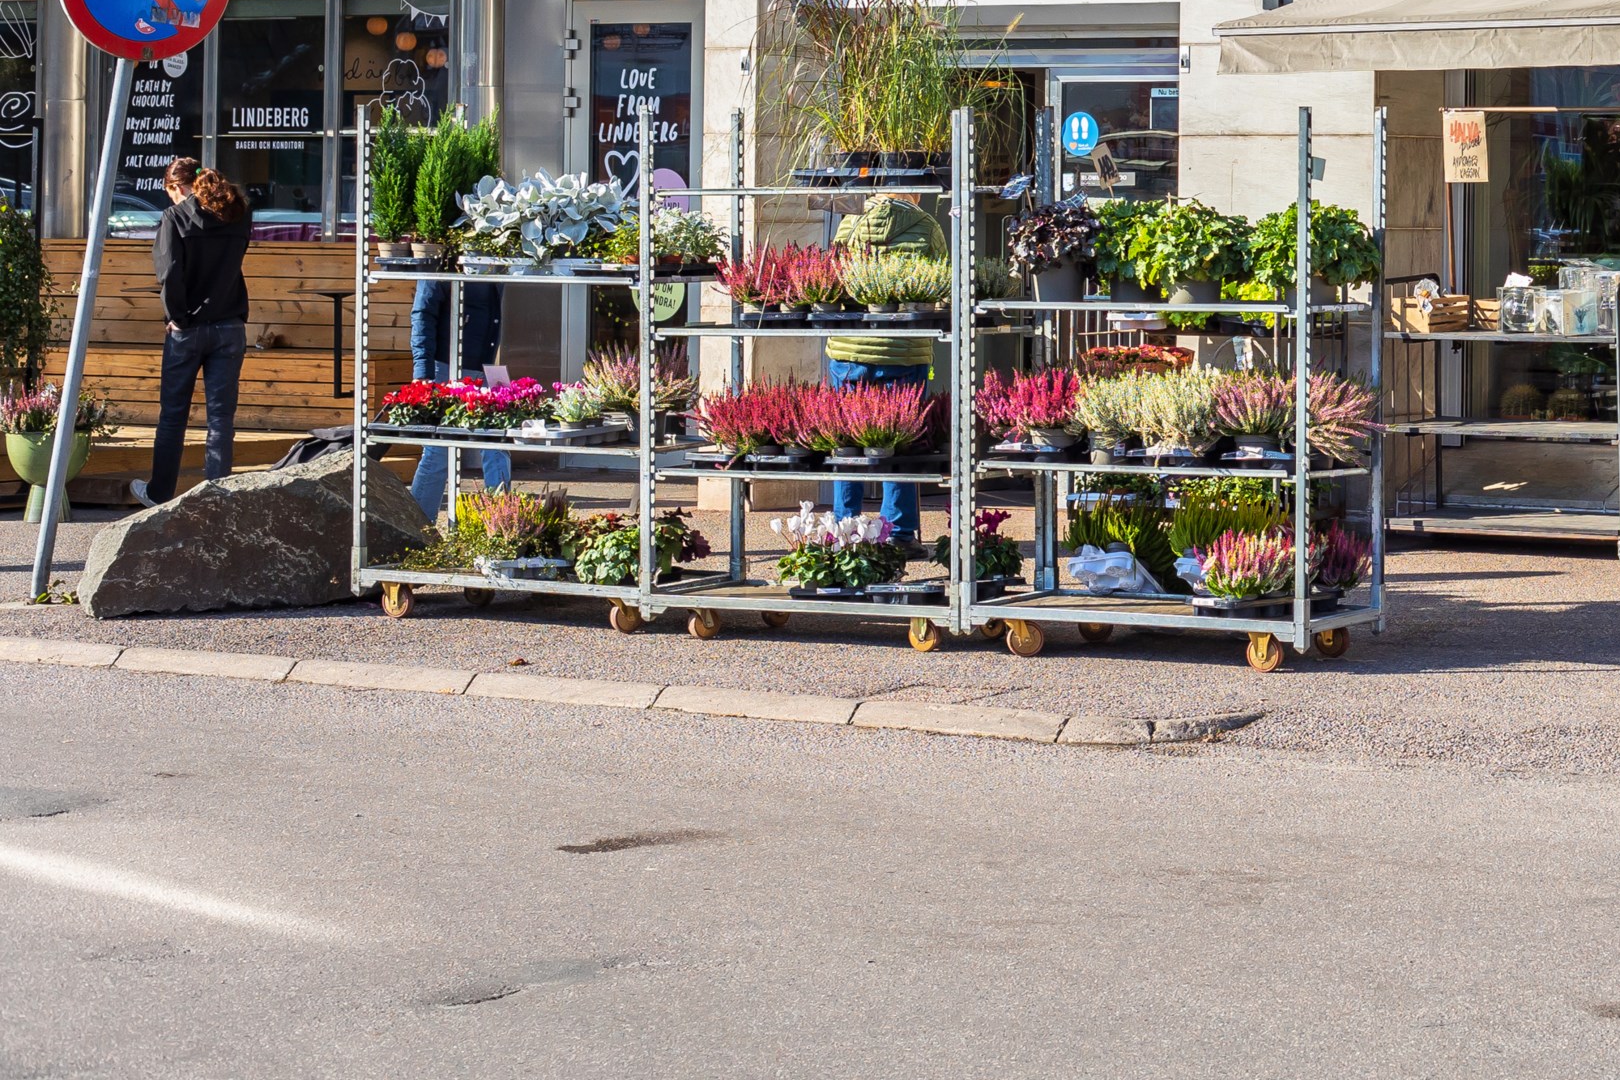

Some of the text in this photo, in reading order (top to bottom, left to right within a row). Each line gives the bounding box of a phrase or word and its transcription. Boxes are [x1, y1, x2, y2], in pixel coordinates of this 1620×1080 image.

[620, 68, 657, 90] LOVE
[135, 80, 172, 93] DEATH BY
[131, 94, 175, 107] CHOCOLATE
[125, 117, 151, 131] BRYNT
[232, 107, 309, 127] LINDEBERG
[132, 131, 173, 145] ROSMARIN
[598, 122, 678, 143] LINDEERG
[235, 141, 305, 150] BAGERI OCH KONDITORI
[125, 154, 178, 168] SALT CARAME
